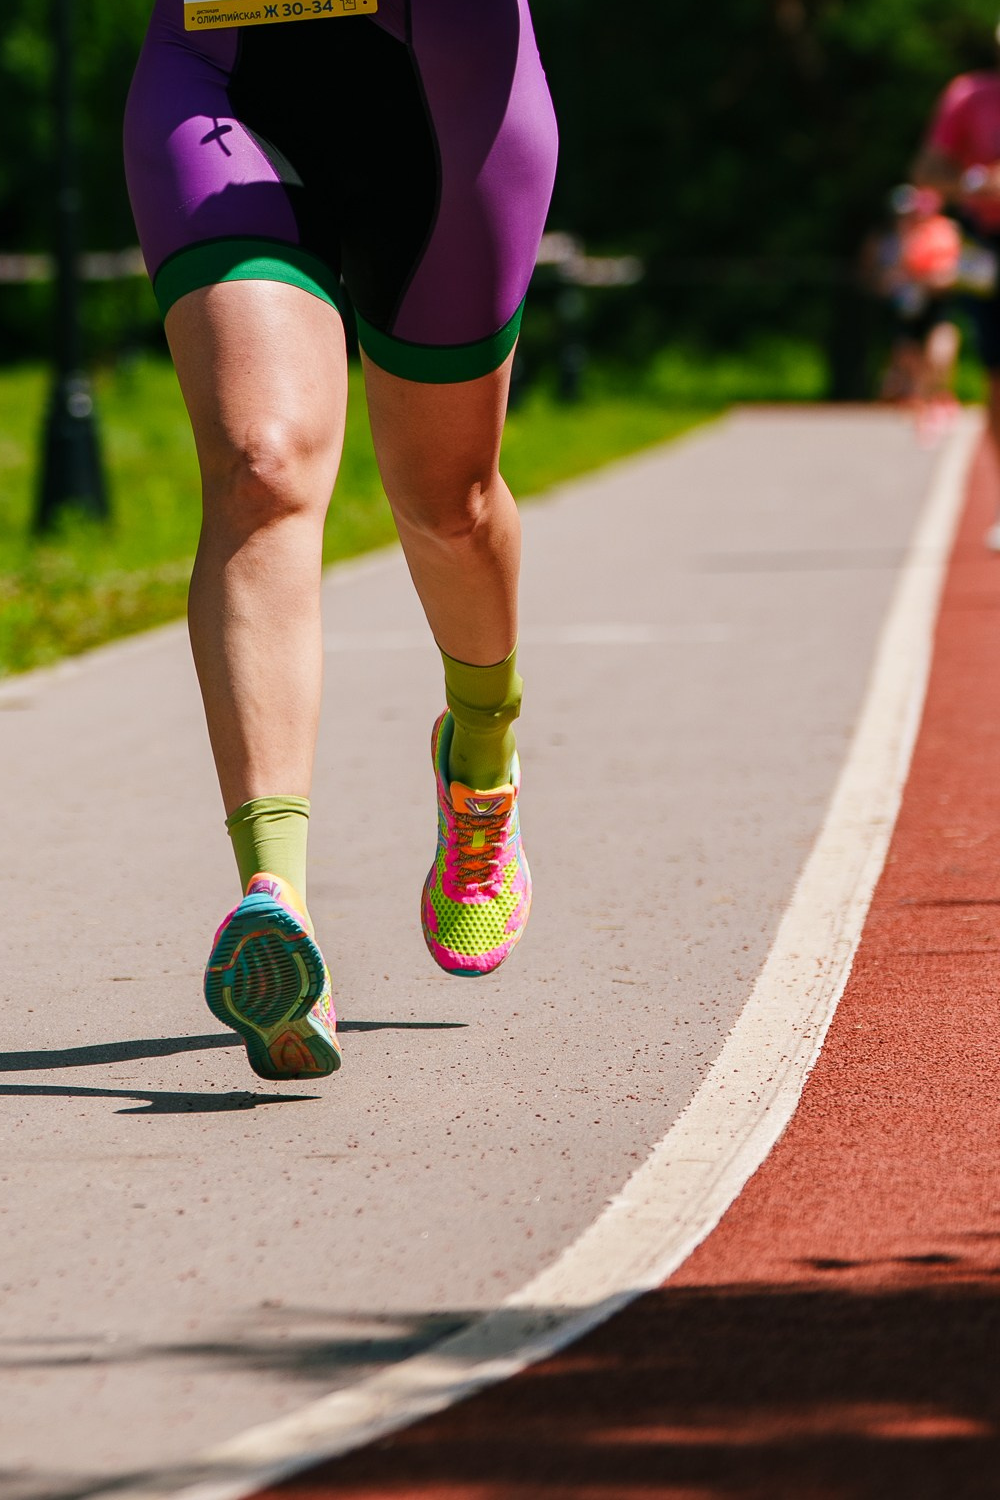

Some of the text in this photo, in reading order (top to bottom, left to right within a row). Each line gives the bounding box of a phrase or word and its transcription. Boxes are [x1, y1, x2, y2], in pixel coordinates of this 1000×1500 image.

[197, 0, 334, 24] ОЛИМПИЙСКАЯ Ж 30-34
